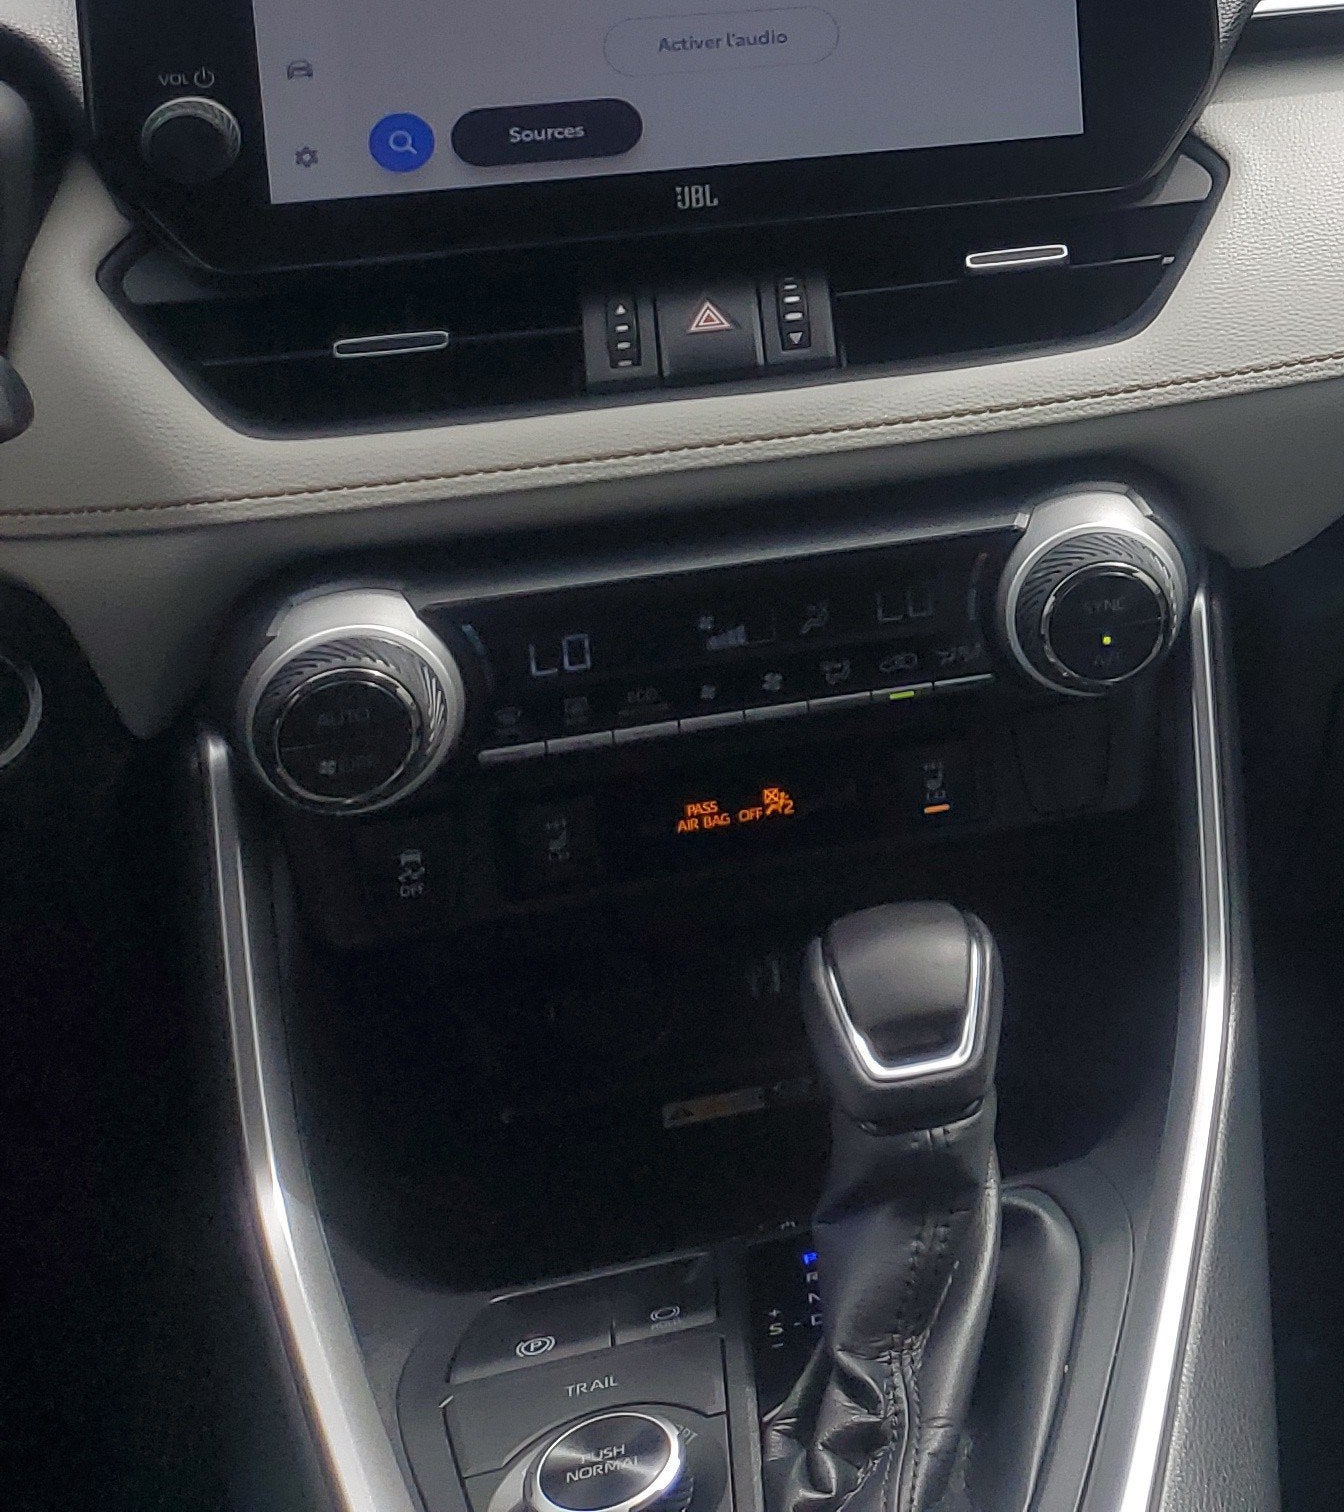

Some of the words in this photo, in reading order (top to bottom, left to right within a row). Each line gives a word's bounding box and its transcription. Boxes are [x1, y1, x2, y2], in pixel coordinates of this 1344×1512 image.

[659, 35, 721, 52] Activer
[726, 29, 788, 48] l'audio
[158, 73, 190, 86] VOL
[509, 125, 585, 143] Sources
[675, 184, 719, 210] JBL
[686, 800, 718, 817] PASS
[677, 817, 699, 833] AIR
[703, 813, 731, 829] BAG
[738, 807, 763, 822] OFF
[566, 1375, 619, 1397] TRAIL
[580, 1443, 626, 1464] PUSH
